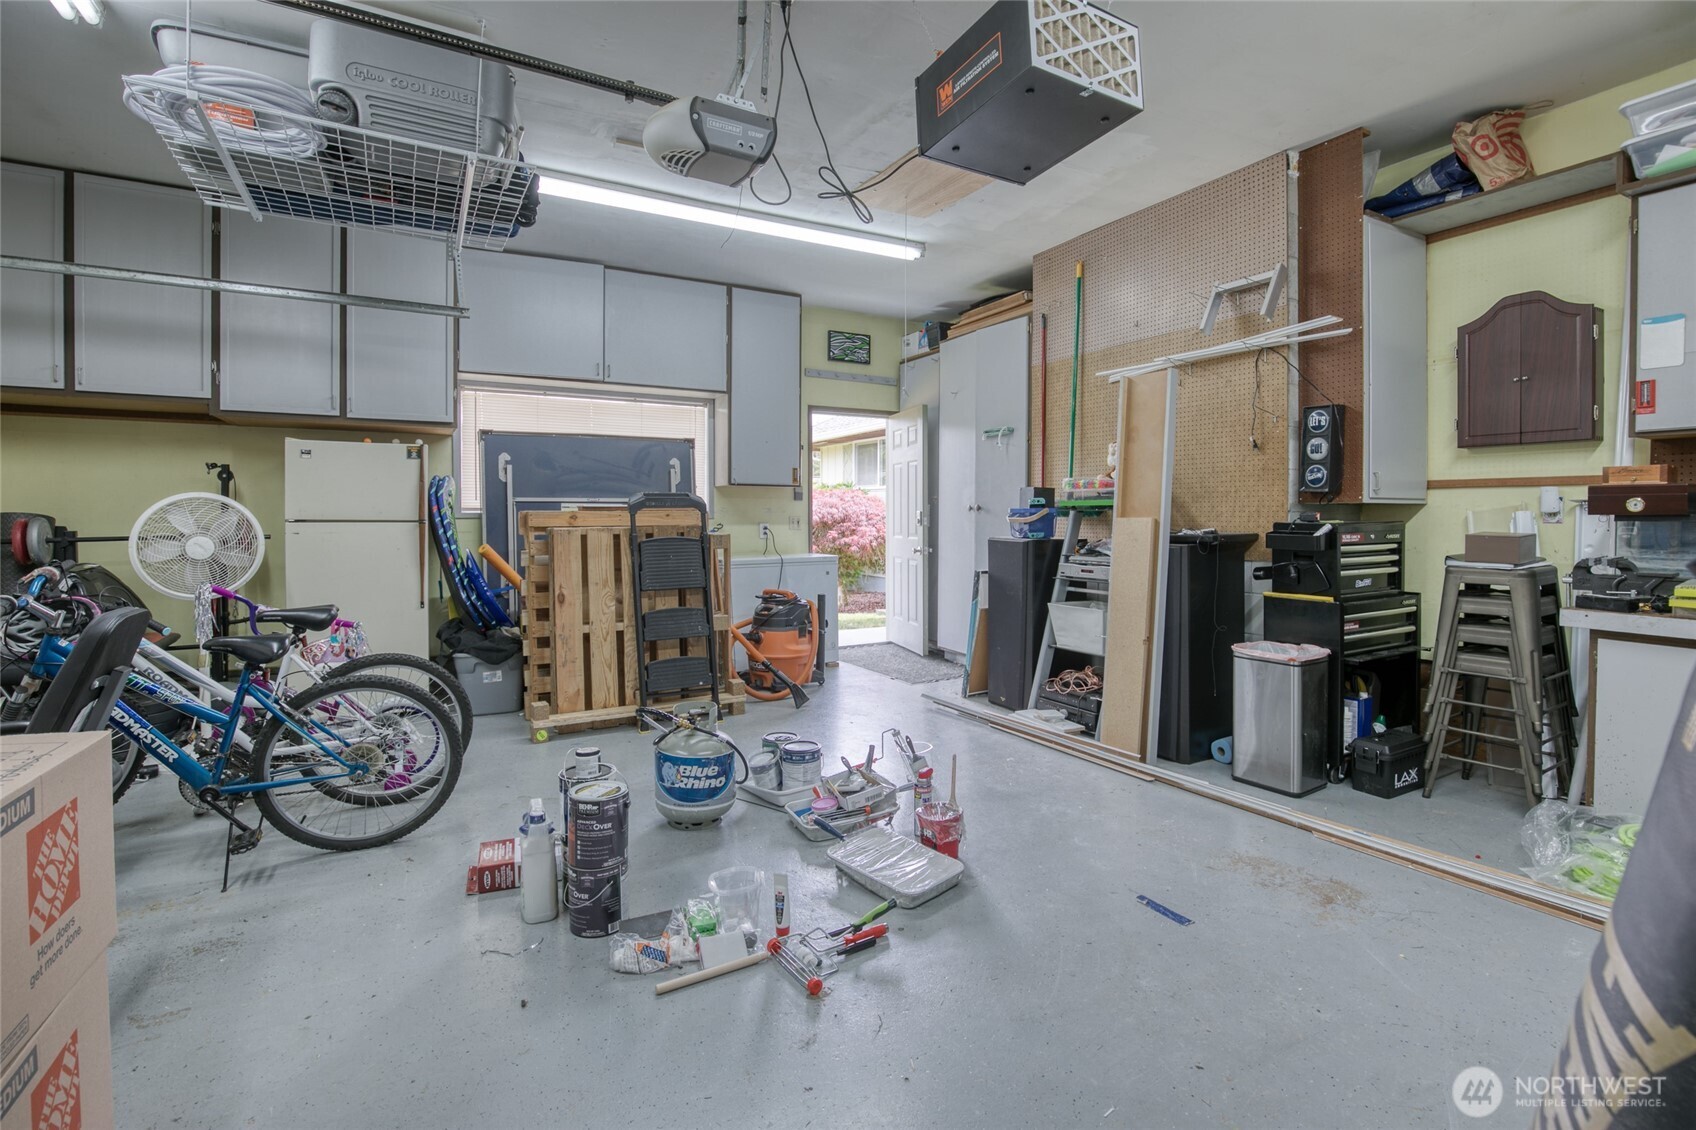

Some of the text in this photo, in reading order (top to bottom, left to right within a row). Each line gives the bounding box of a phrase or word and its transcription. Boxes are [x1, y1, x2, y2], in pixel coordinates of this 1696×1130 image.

[982, 51, 999, 69] SYSTEM
[353, 66, 479, 107] igloo COOL ROLLER
[709, 120, 741, 134] CRAFTSMAN
[1309, 415, 1326, 427] LET'S
[1310, 442, 1323, 455] GO!
[676, 775, 726, 789] Rhino
[679, 765, 719, 777] Blue
[1394, 767, 1418, 786] LAX
[29, 800, 79, 937] HOME
[33, 828, 56, 880] THE
[50, 834, 79, 920] DEPOT
[37, 915, 76, 962] How doers
[29, 924, 83, 990] get more done.
[48, 1036, 79, 1130] OME
